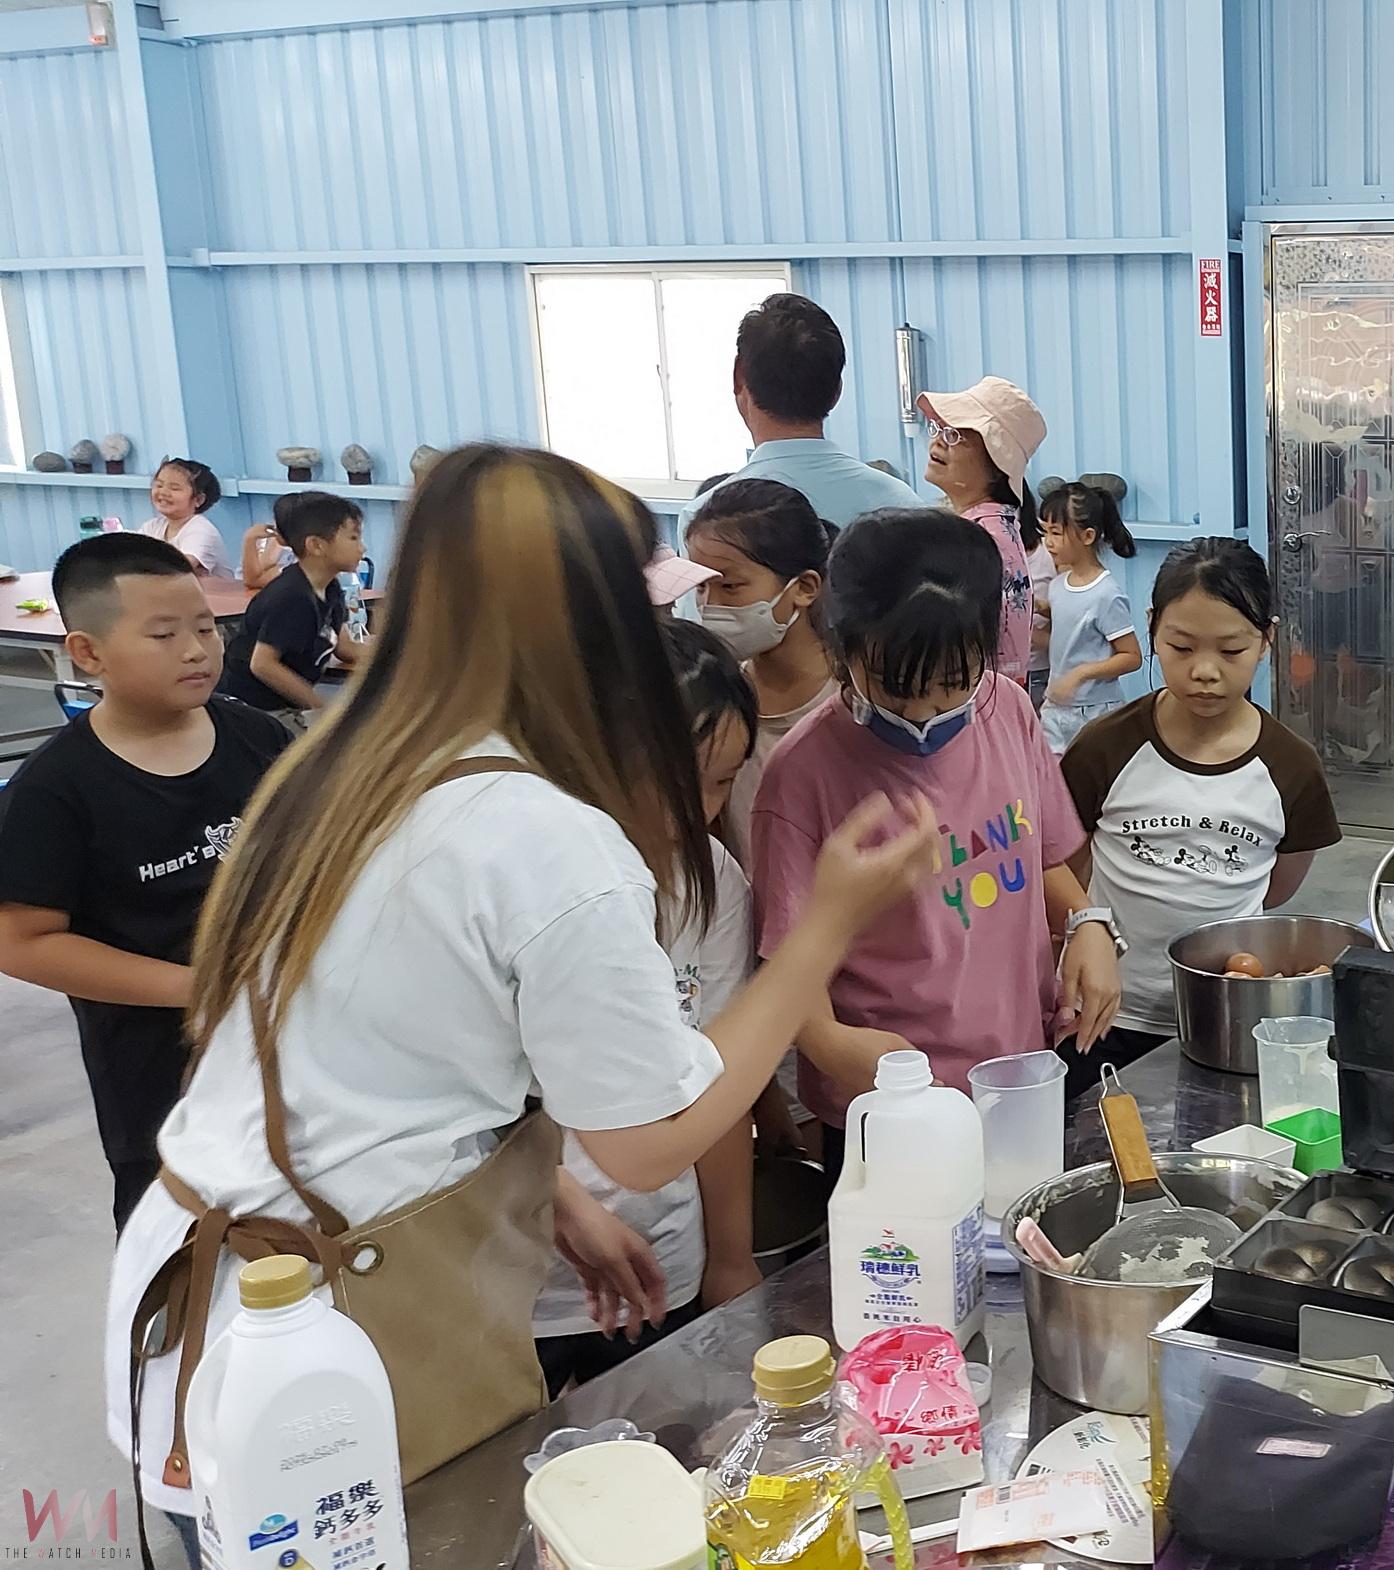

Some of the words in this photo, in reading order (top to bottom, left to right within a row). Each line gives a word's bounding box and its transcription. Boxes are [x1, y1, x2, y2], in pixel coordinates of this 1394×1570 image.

[1201, 260, 1220, 269] FIRE
[1204, 272, 1218, 322] 滅火器
[1121, 815, 1191, 833] Stretch
[1199, 817, 1213, 829] &
[1219, 820, 1264, 847] Relax
[942, 858, 1025, 929] YOU
[860, 1261, 920, 1276] 瑞穗鮮乳
[315, 1479, 380, 1515] 福樂
[314, 1499, 384, 1539] 鈣多多
